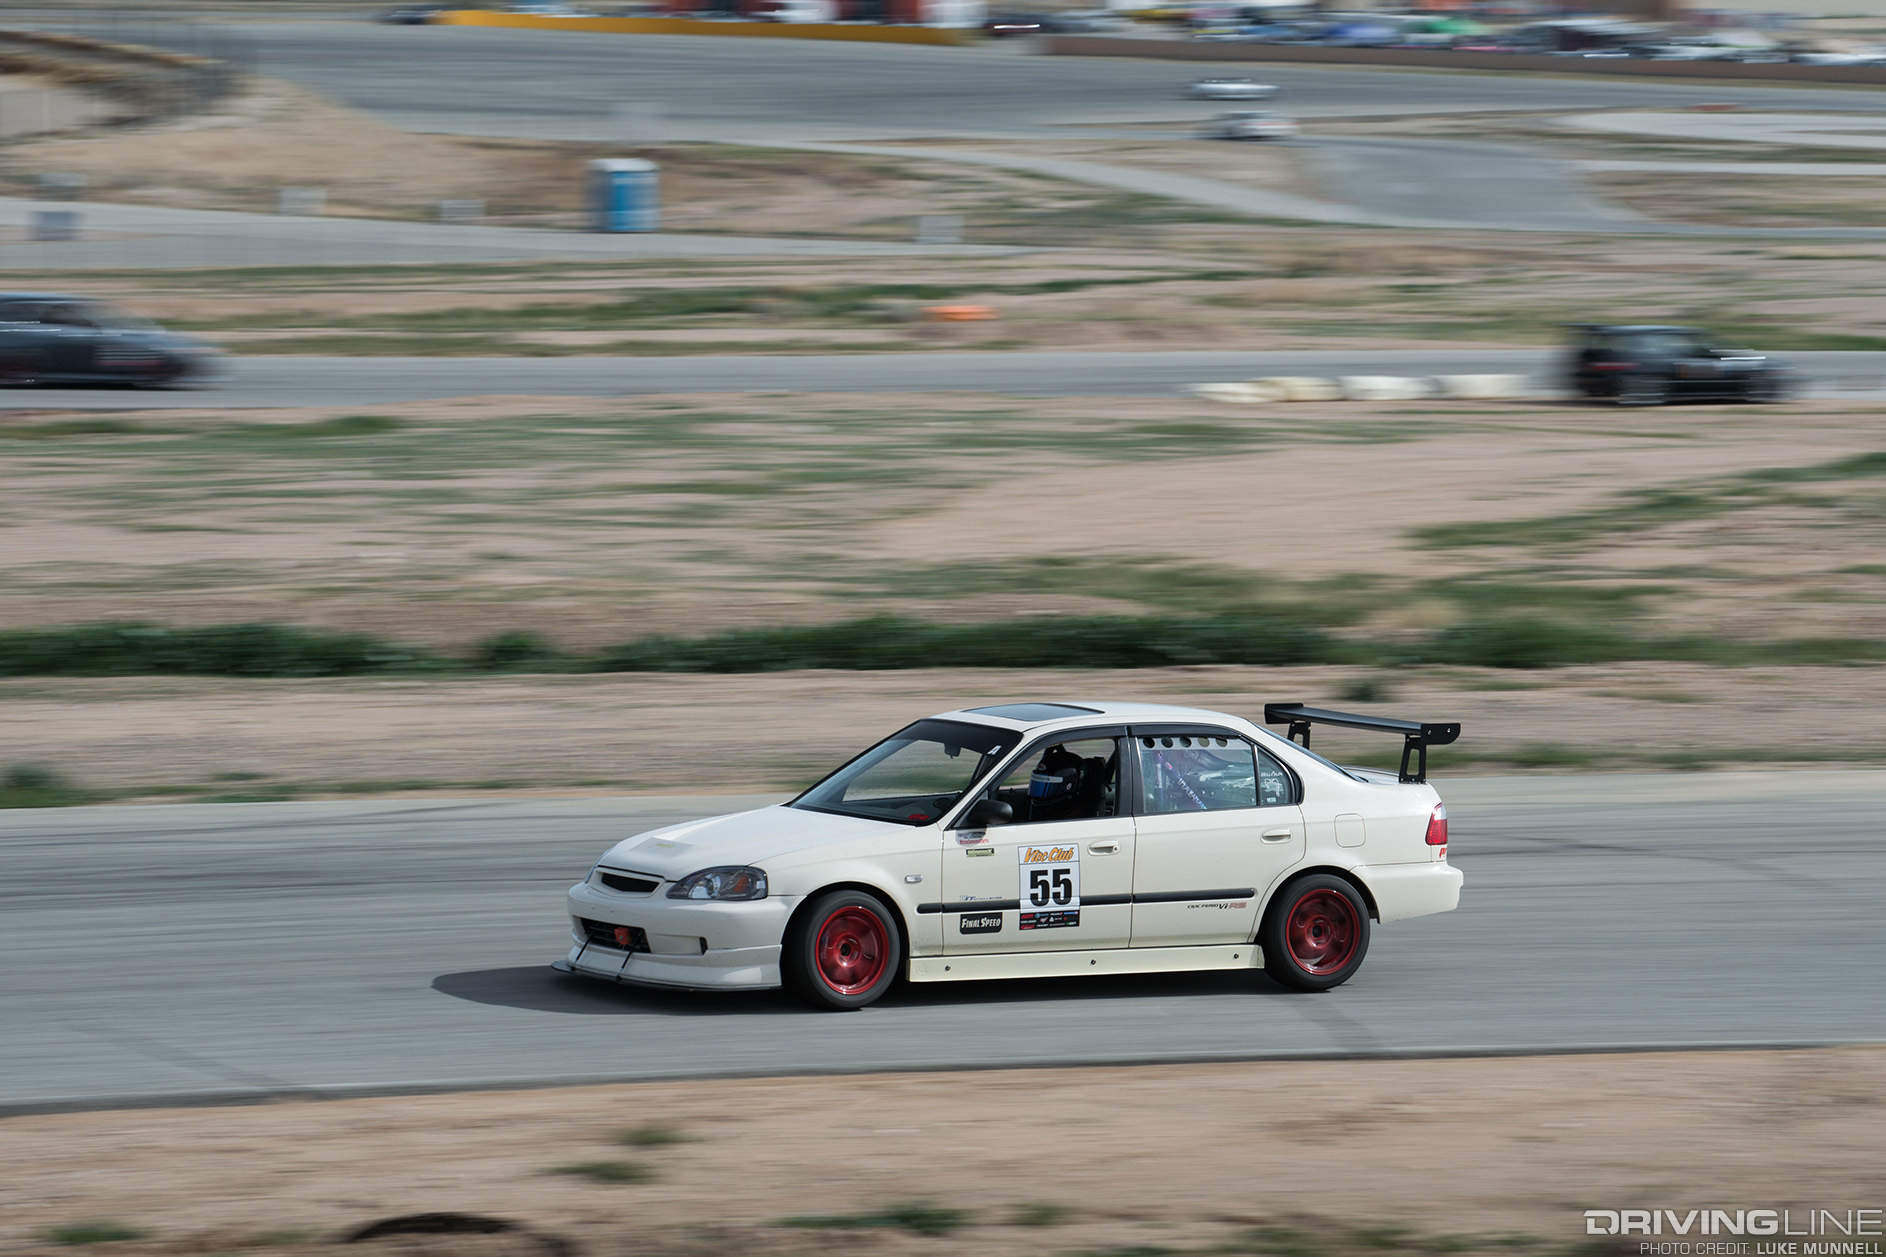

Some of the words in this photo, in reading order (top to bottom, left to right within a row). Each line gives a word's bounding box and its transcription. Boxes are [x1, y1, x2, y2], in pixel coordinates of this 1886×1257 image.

[1024, 848, 1048, 863] Vtec
[1048, 847, 1075, 862] Club
[1030, 868, 1072, 907] 55
[961, 918, 980, 928] FINAL
[981, 917, 1001, 928] SPEED
